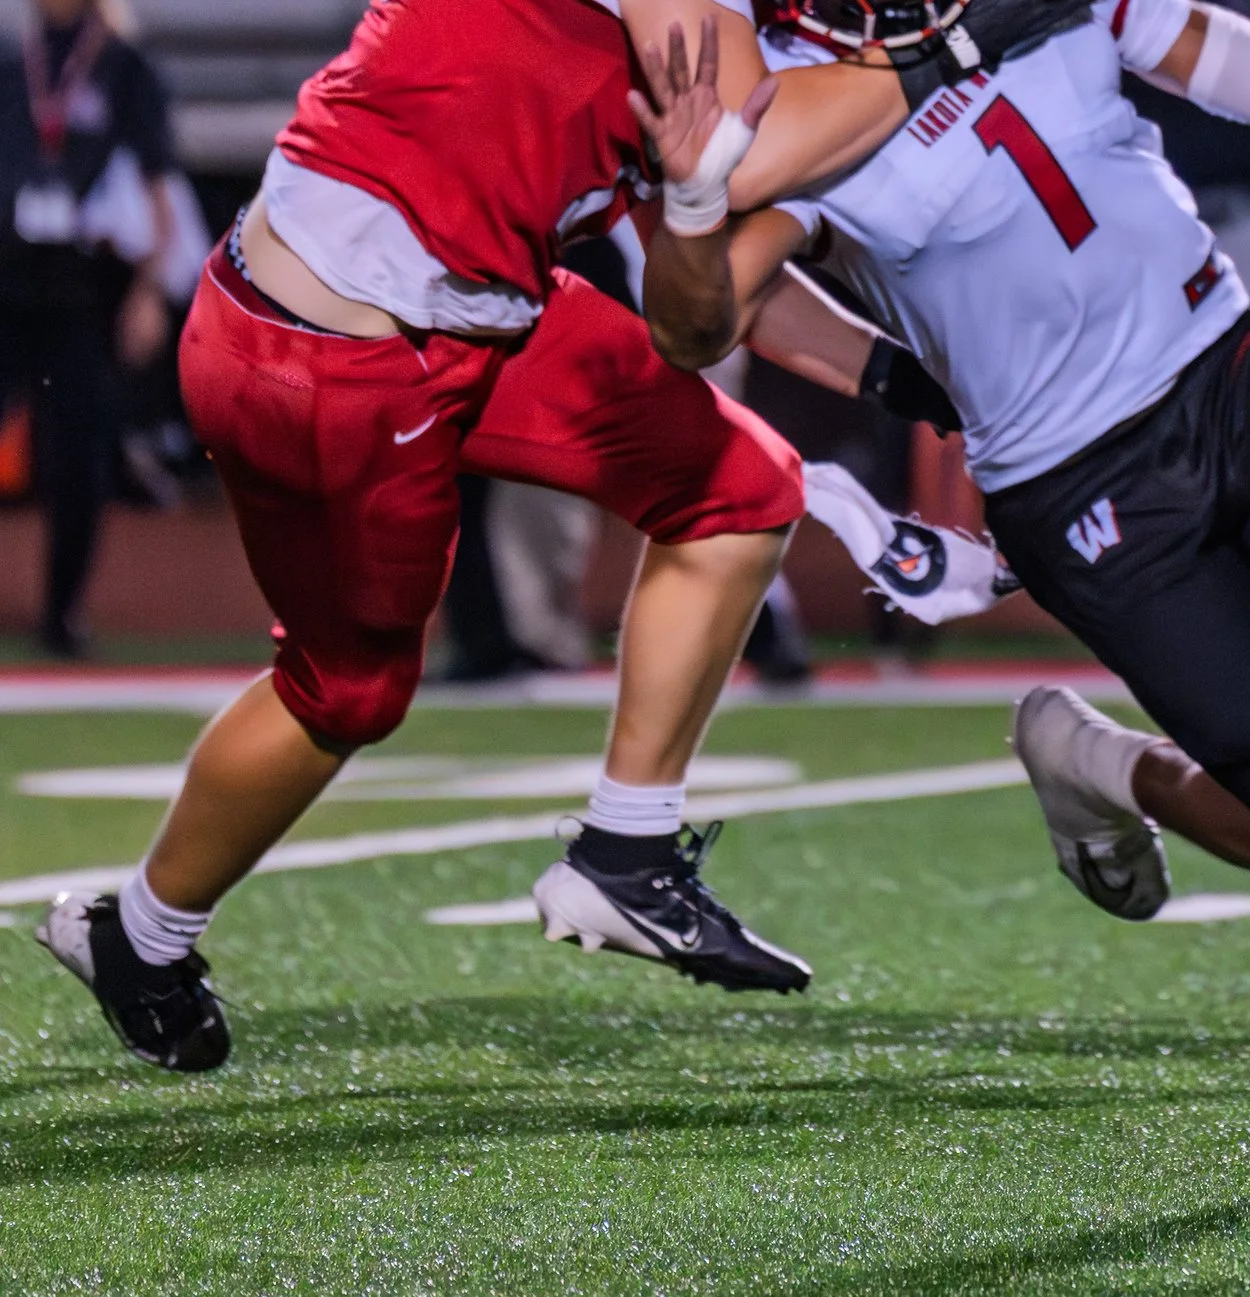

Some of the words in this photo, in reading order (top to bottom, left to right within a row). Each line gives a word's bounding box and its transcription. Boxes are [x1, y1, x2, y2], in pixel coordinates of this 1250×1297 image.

[906, 86, 974, 149] LAKOTA
[970, 91, 1099, 255] 1
[1065, 497, 1122, 565] W
